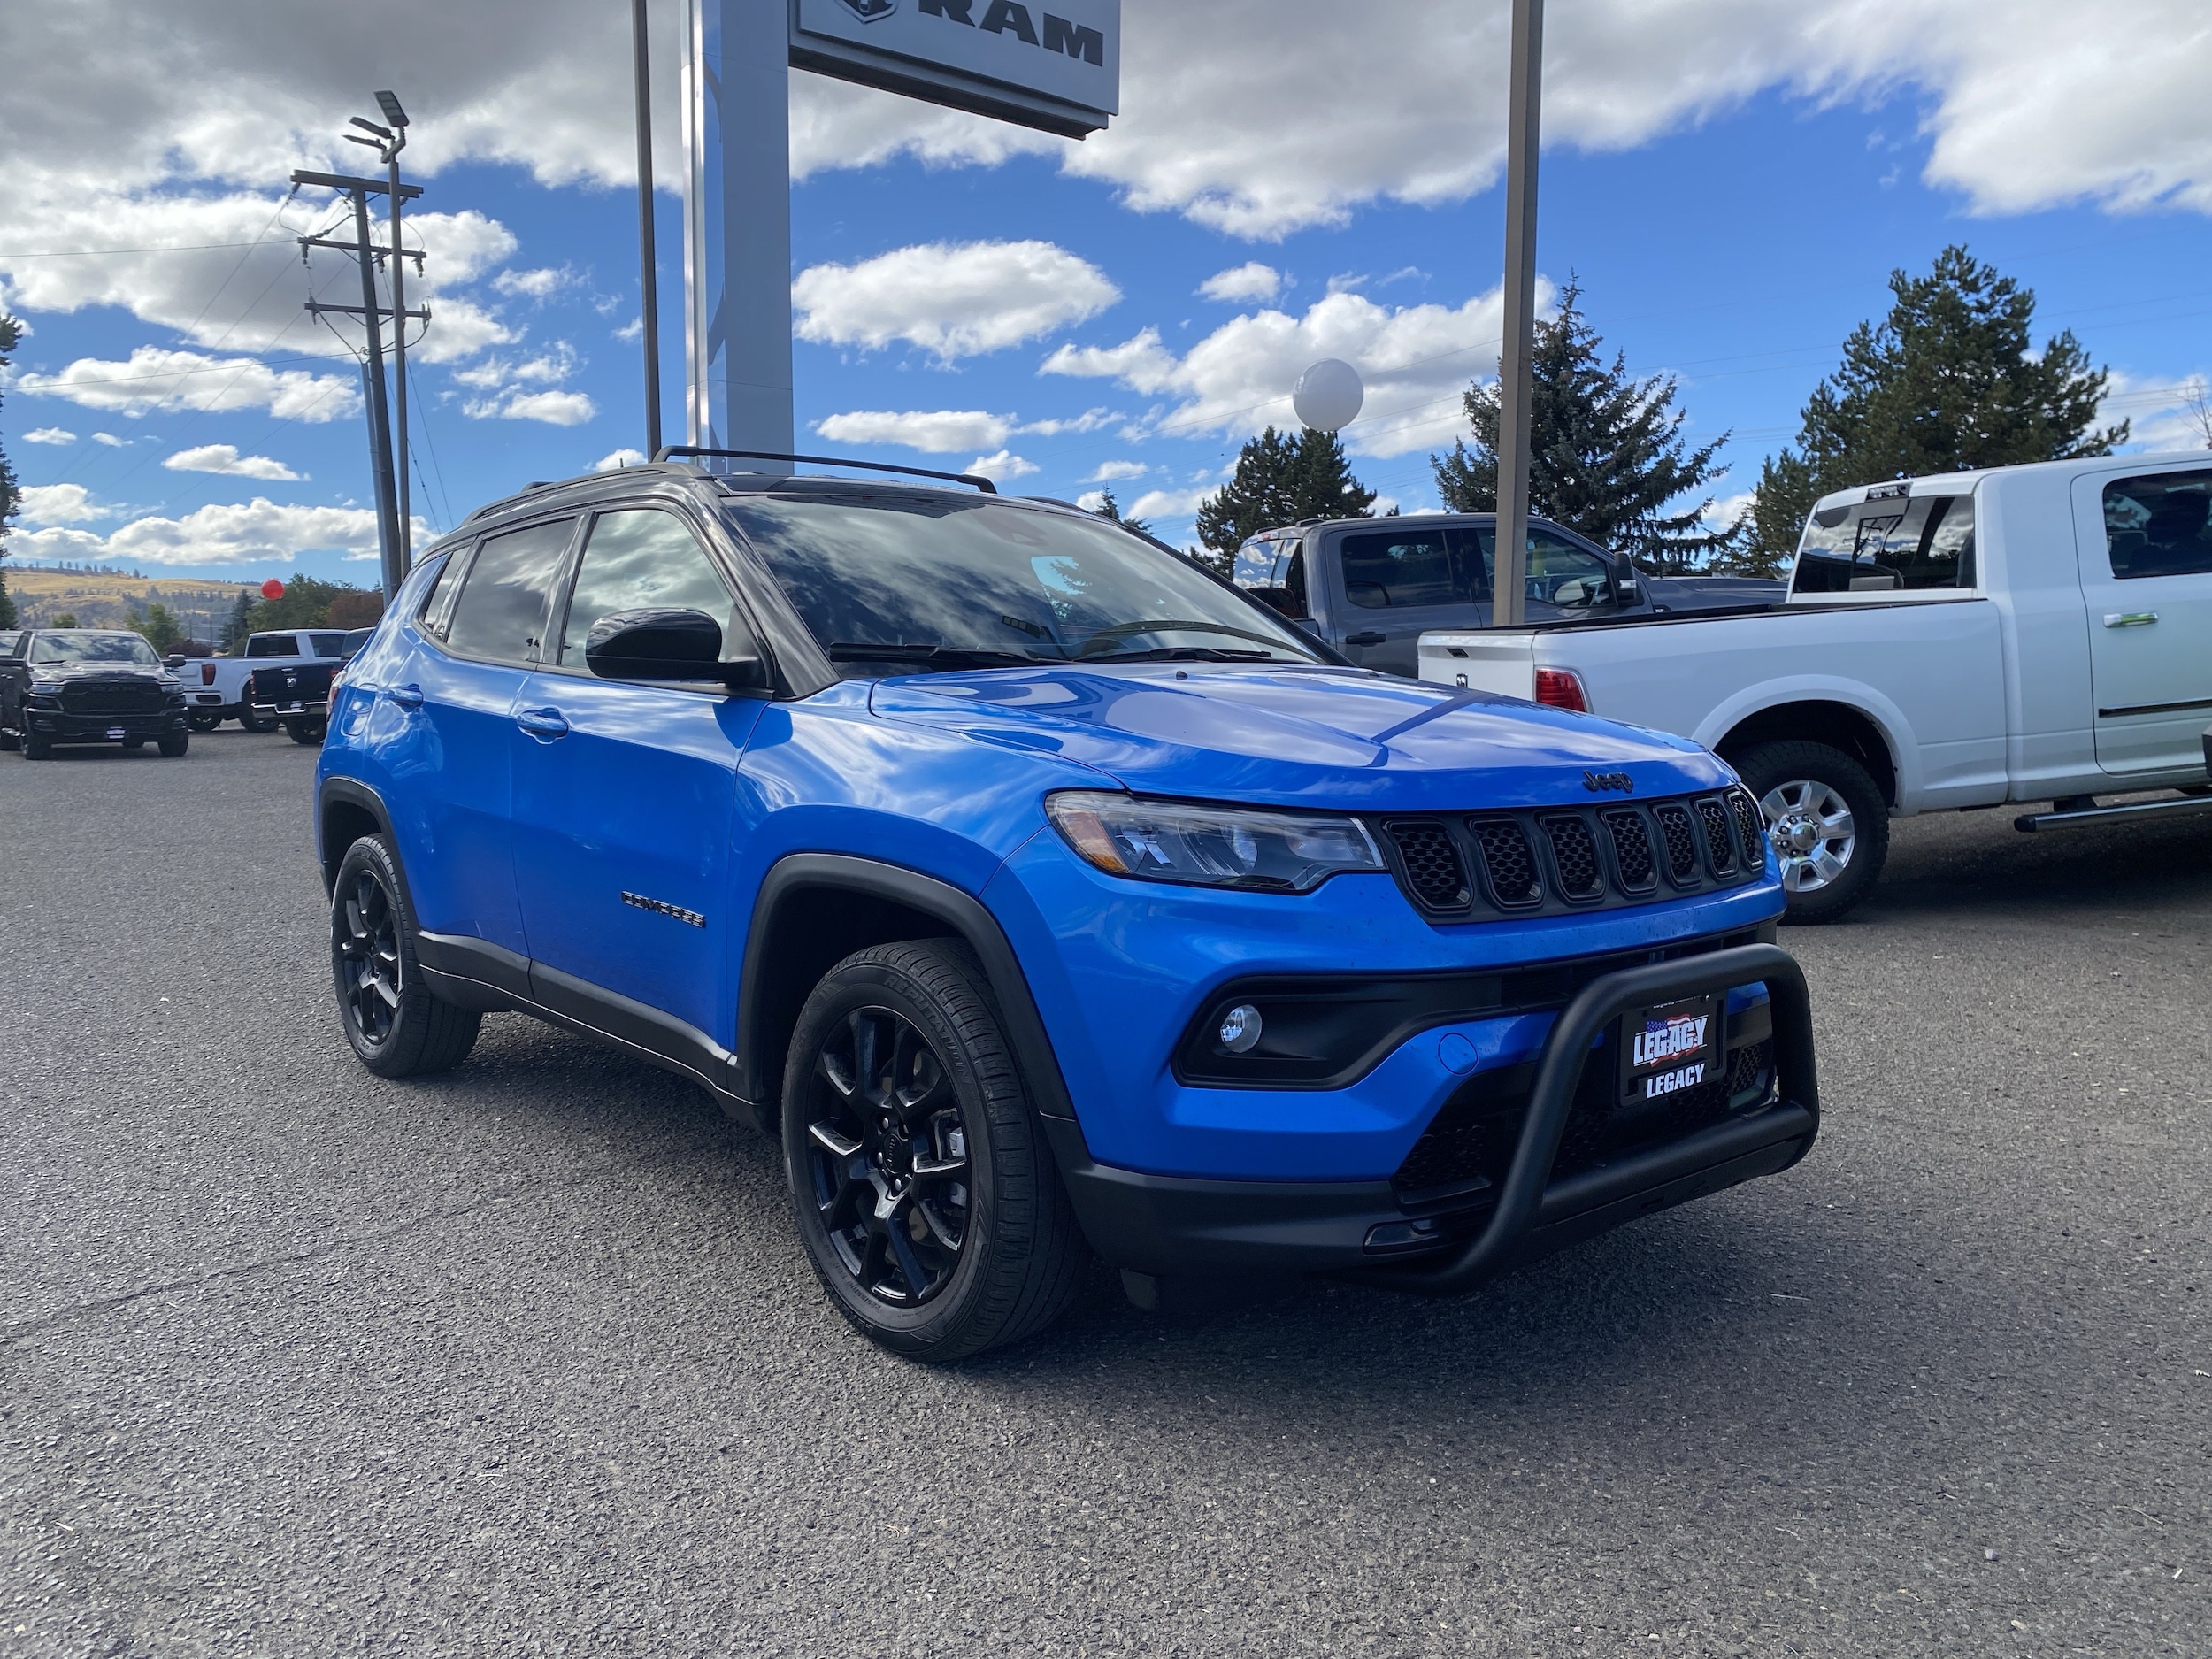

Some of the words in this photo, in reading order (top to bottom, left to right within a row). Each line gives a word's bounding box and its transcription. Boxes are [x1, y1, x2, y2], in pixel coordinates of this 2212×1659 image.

[1581, 769, 1634, 794] Jeep
[1633, 1017, 1709, 1064] LEGACY
[1647, 1063, 1706, 1099] LEGACY
